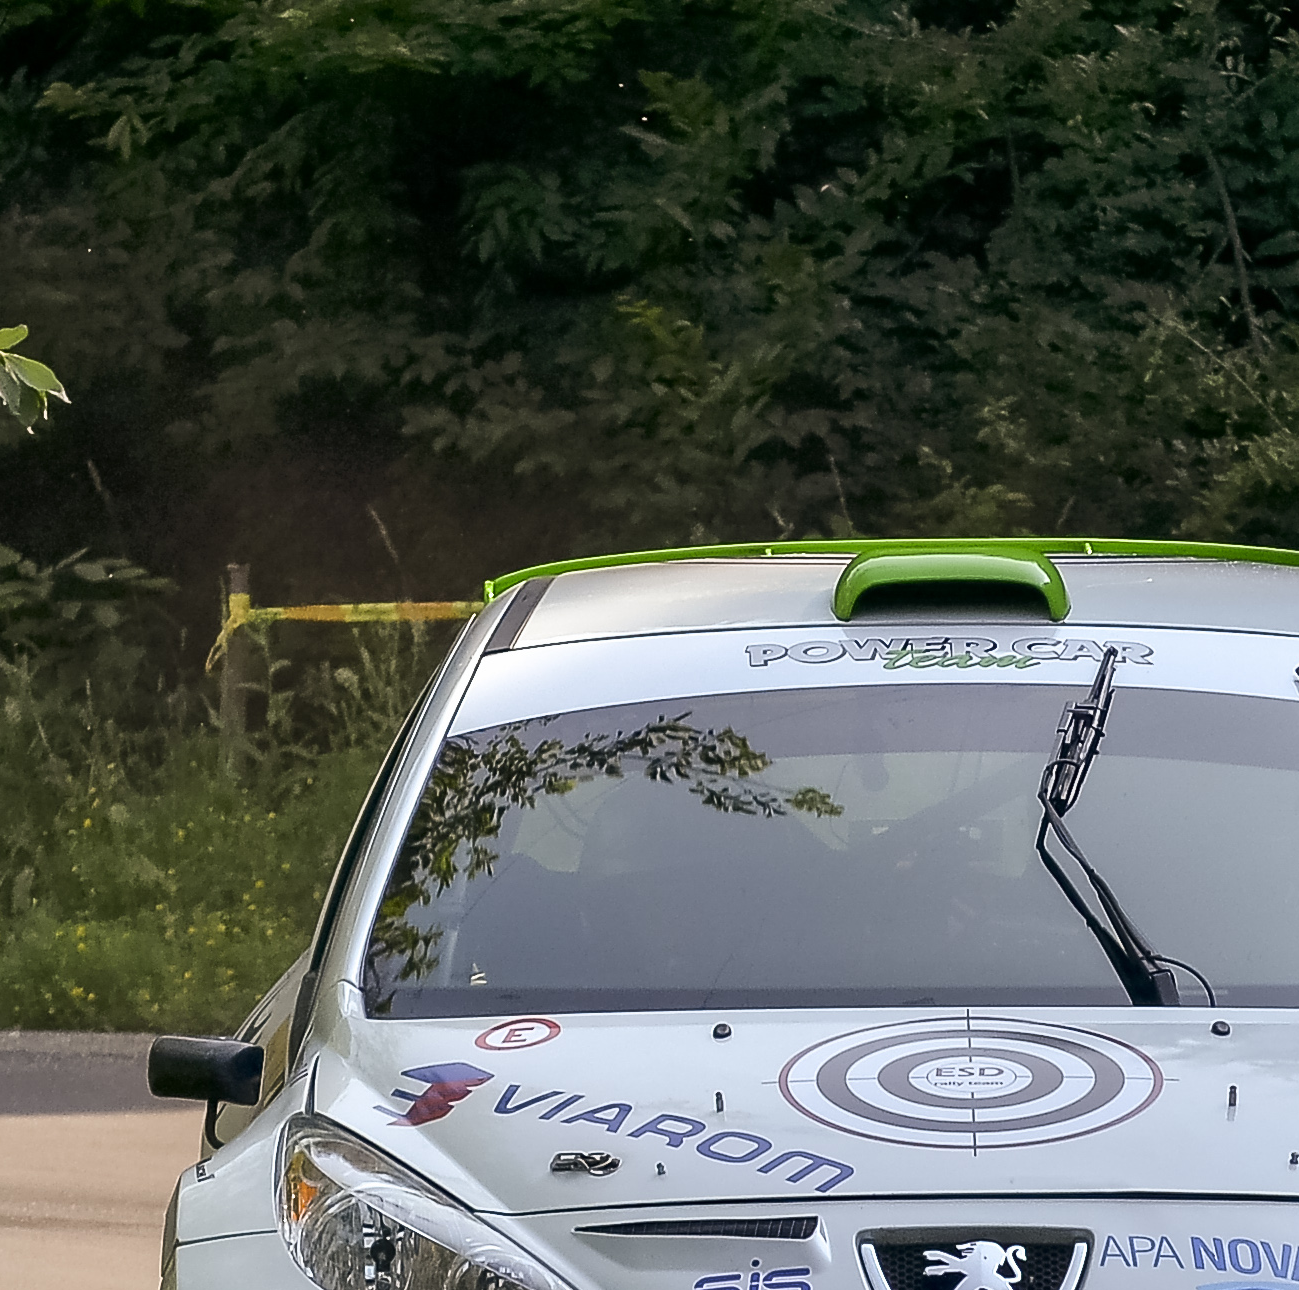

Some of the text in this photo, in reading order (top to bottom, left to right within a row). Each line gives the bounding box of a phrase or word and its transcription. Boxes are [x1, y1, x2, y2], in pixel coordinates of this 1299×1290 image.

[745, 636, 1155, 667] POWER CAR
[882, 649, 1042, 670] team
[504, 1026, 535, 1044] E
[935, 1067, 1004, 1077] ESD
[493, 1084, 855, 1194] VIAROM
[1100, 1235, 1185, 1270] APA
